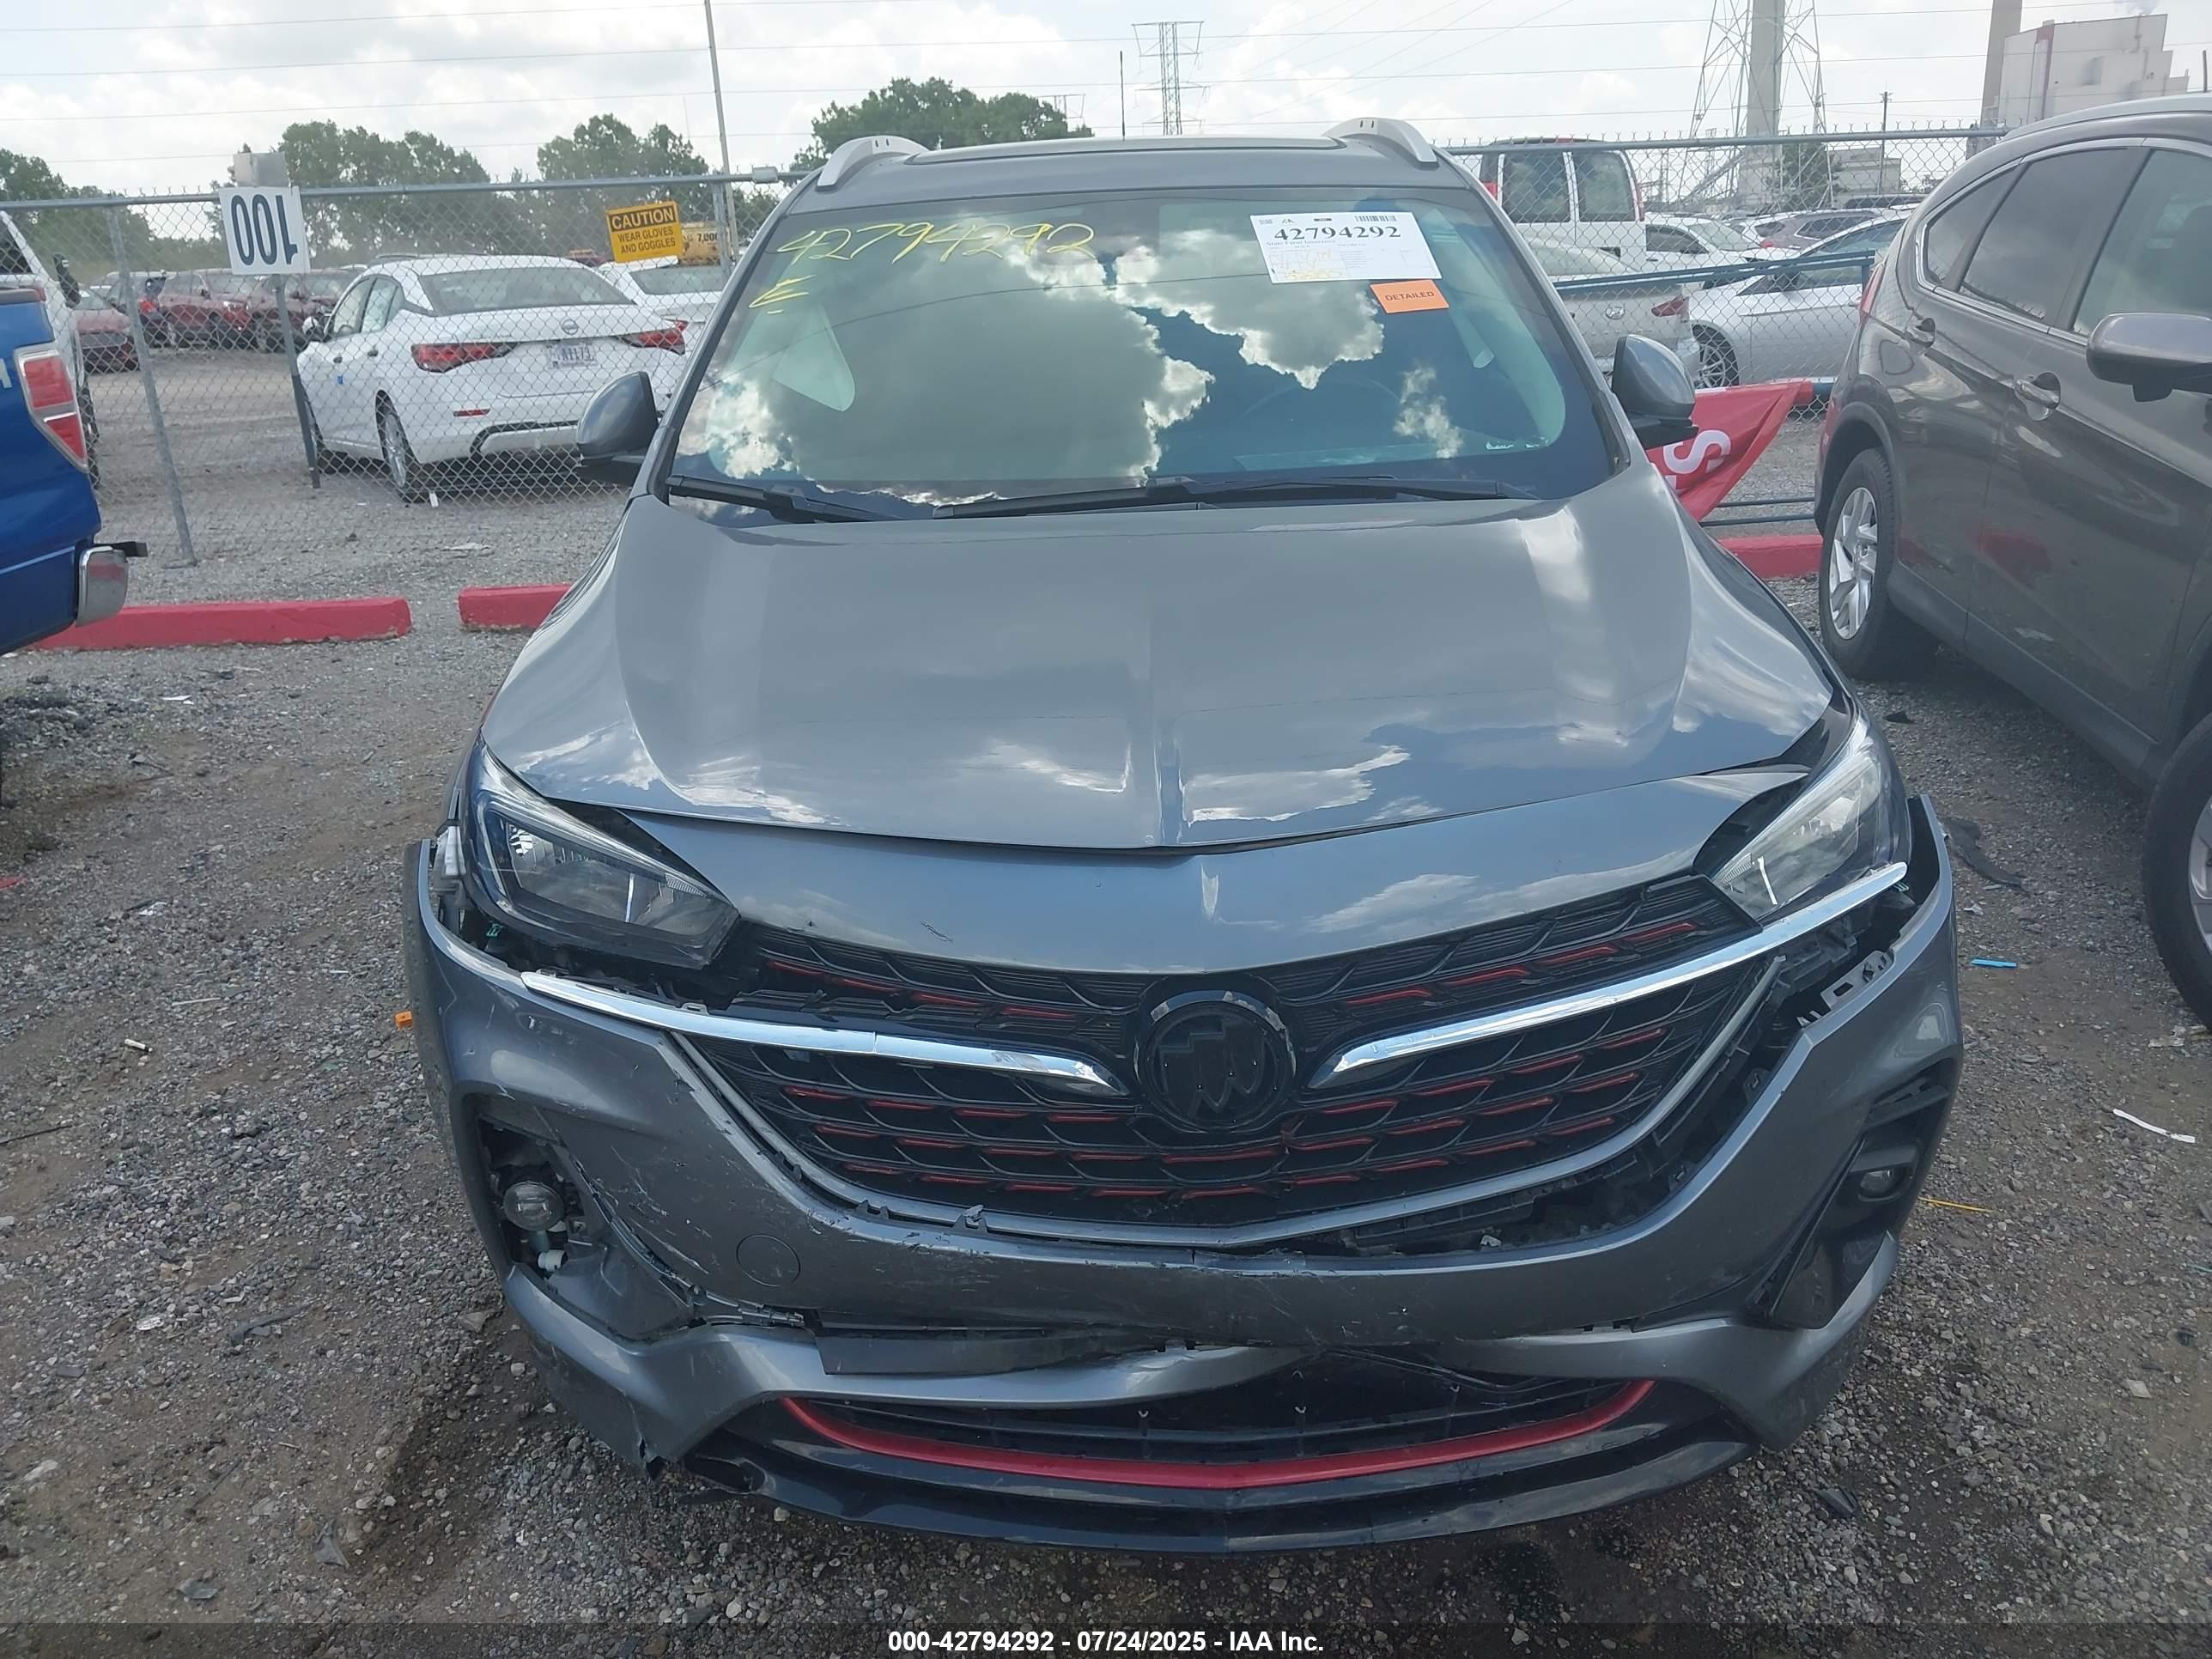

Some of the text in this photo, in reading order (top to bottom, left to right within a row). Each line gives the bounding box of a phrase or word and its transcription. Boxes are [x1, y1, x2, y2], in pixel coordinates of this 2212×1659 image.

[611, 207, 674, 230] CAUTION
[230, 194, 299, 266] 100
[617, 232, 641, 244] WEAR
[641, 226, 675, 240] GLOVES
[1273, 226, 1401, 240] 42794292
[620, 242, 637, 255] AND
[639, 237, 677, 252] GOGGLES
[776, 221, 1097, 266] 42794292
[1384, 291, 1436, 301] DETAILED
